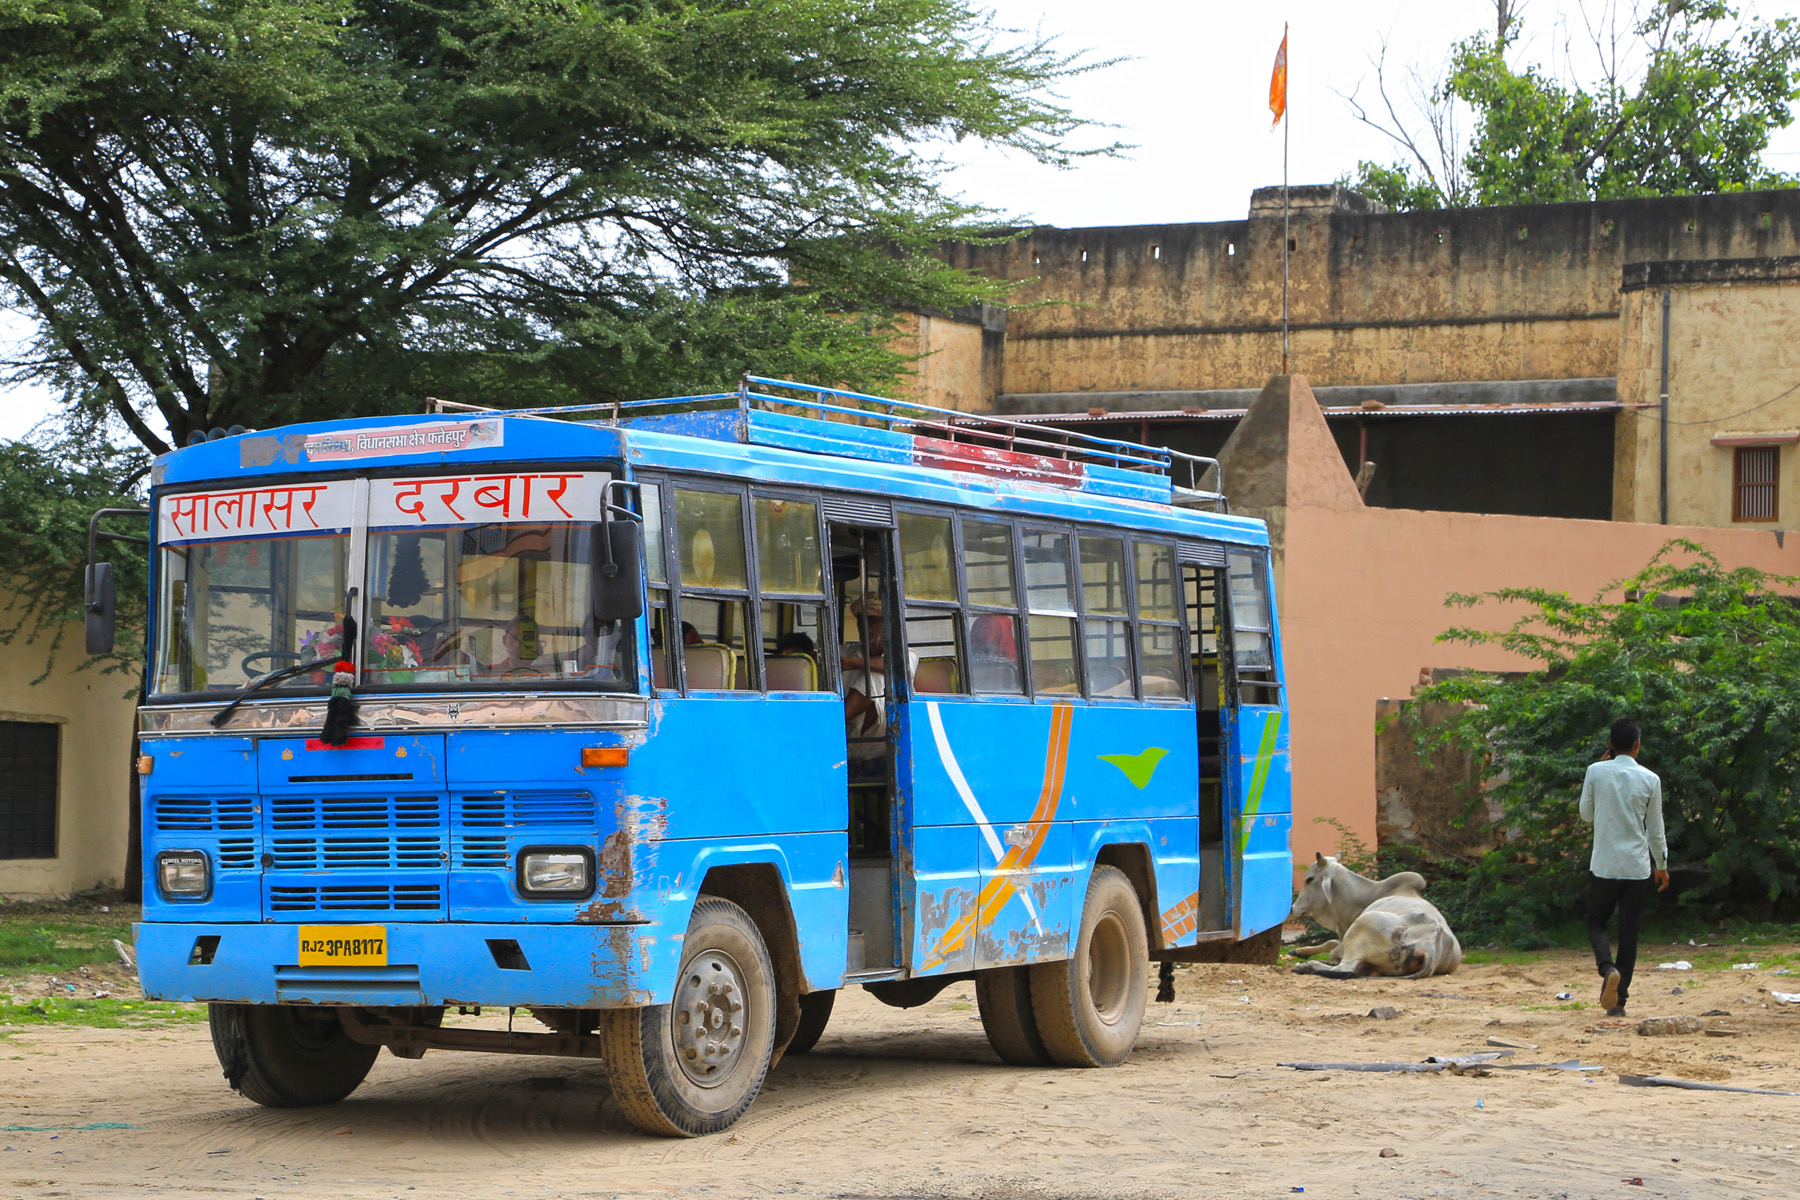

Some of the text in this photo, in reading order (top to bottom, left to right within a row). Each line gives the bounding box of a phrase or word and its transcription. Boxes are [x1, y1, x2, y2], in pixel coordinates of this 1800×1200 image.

[357, 433, 407, 451] विधानसभा
[408, 429, 426, 447] क्षेत्र
[426, 427, 468, 447] फतेहपुर
[169, 474, 584, 537] सालासर दरबार
